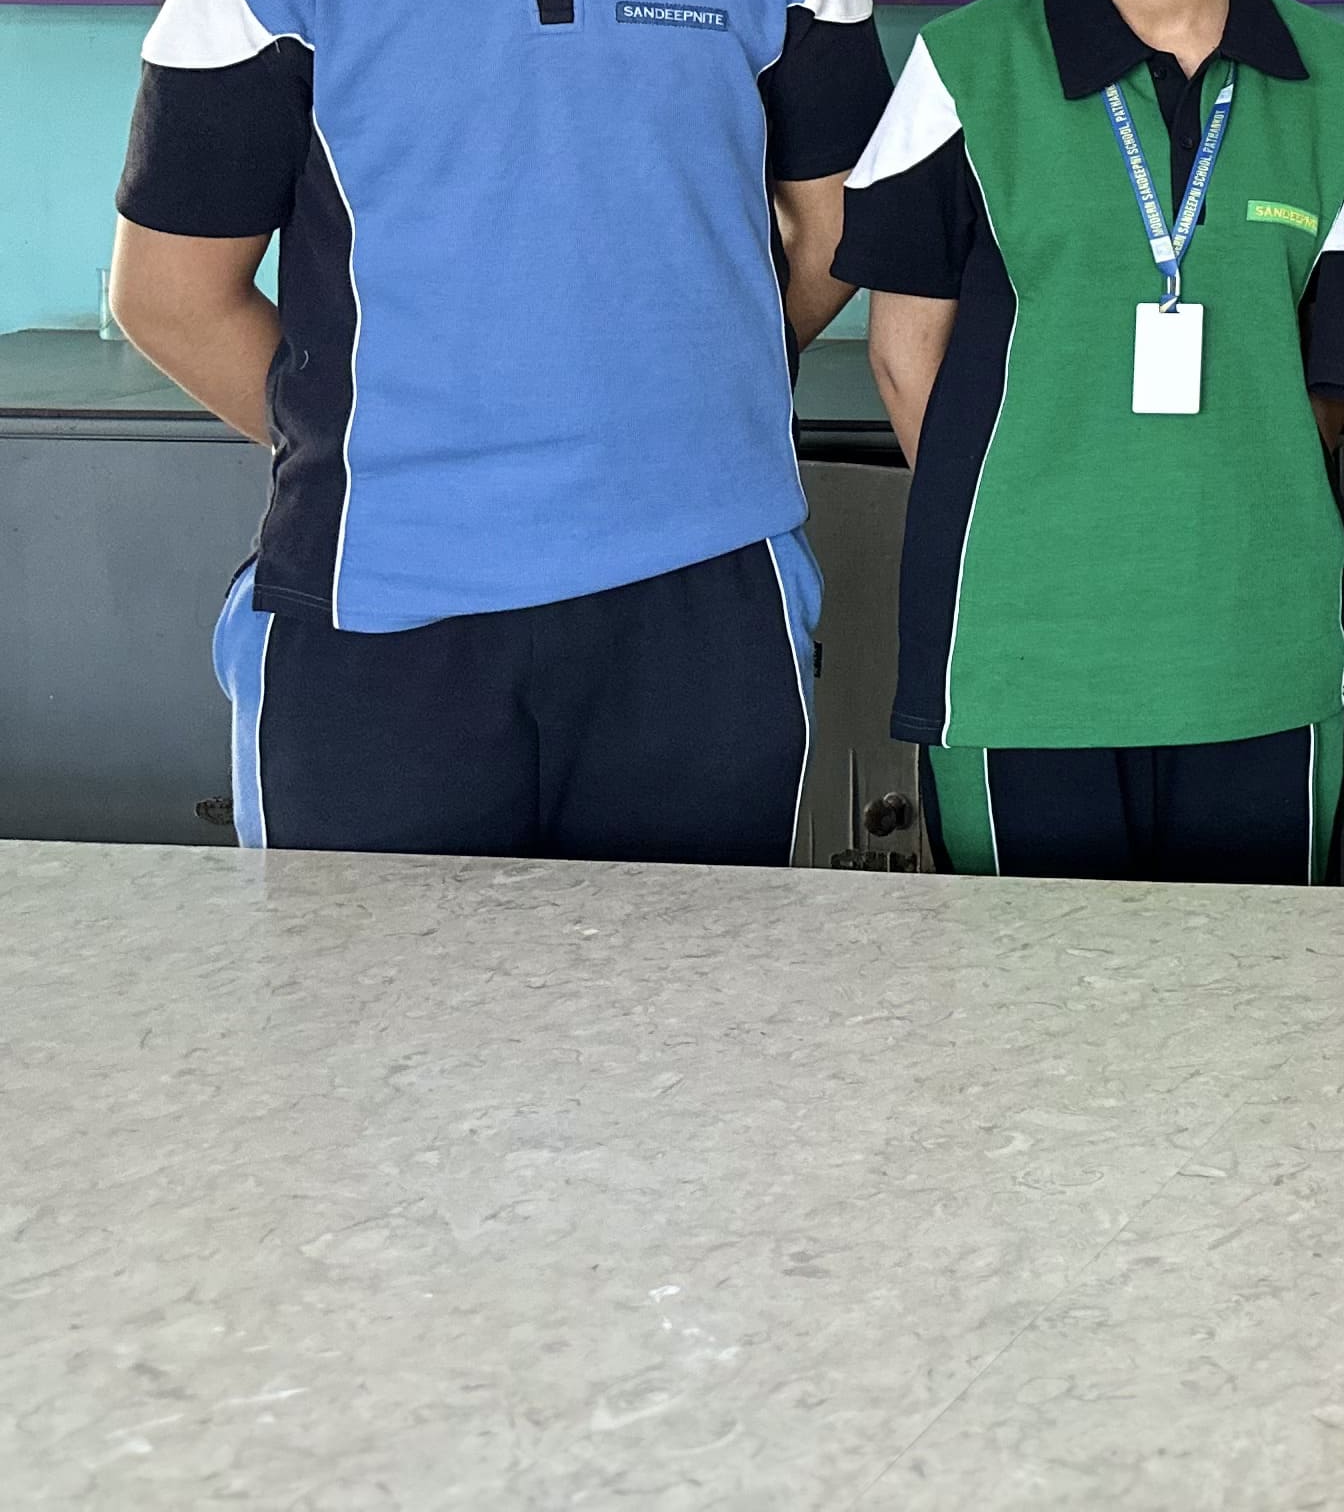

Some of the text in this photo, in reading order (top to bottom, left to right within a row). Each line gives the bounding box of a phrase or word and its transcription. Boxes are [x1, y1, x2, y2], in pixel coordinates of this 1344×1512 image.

[624, 6, 724, 26] SANDEEPNITE
[1144, 201, 1164, 237] MODERN
[1179, 190, 1201, 234] SANDEEPNI
